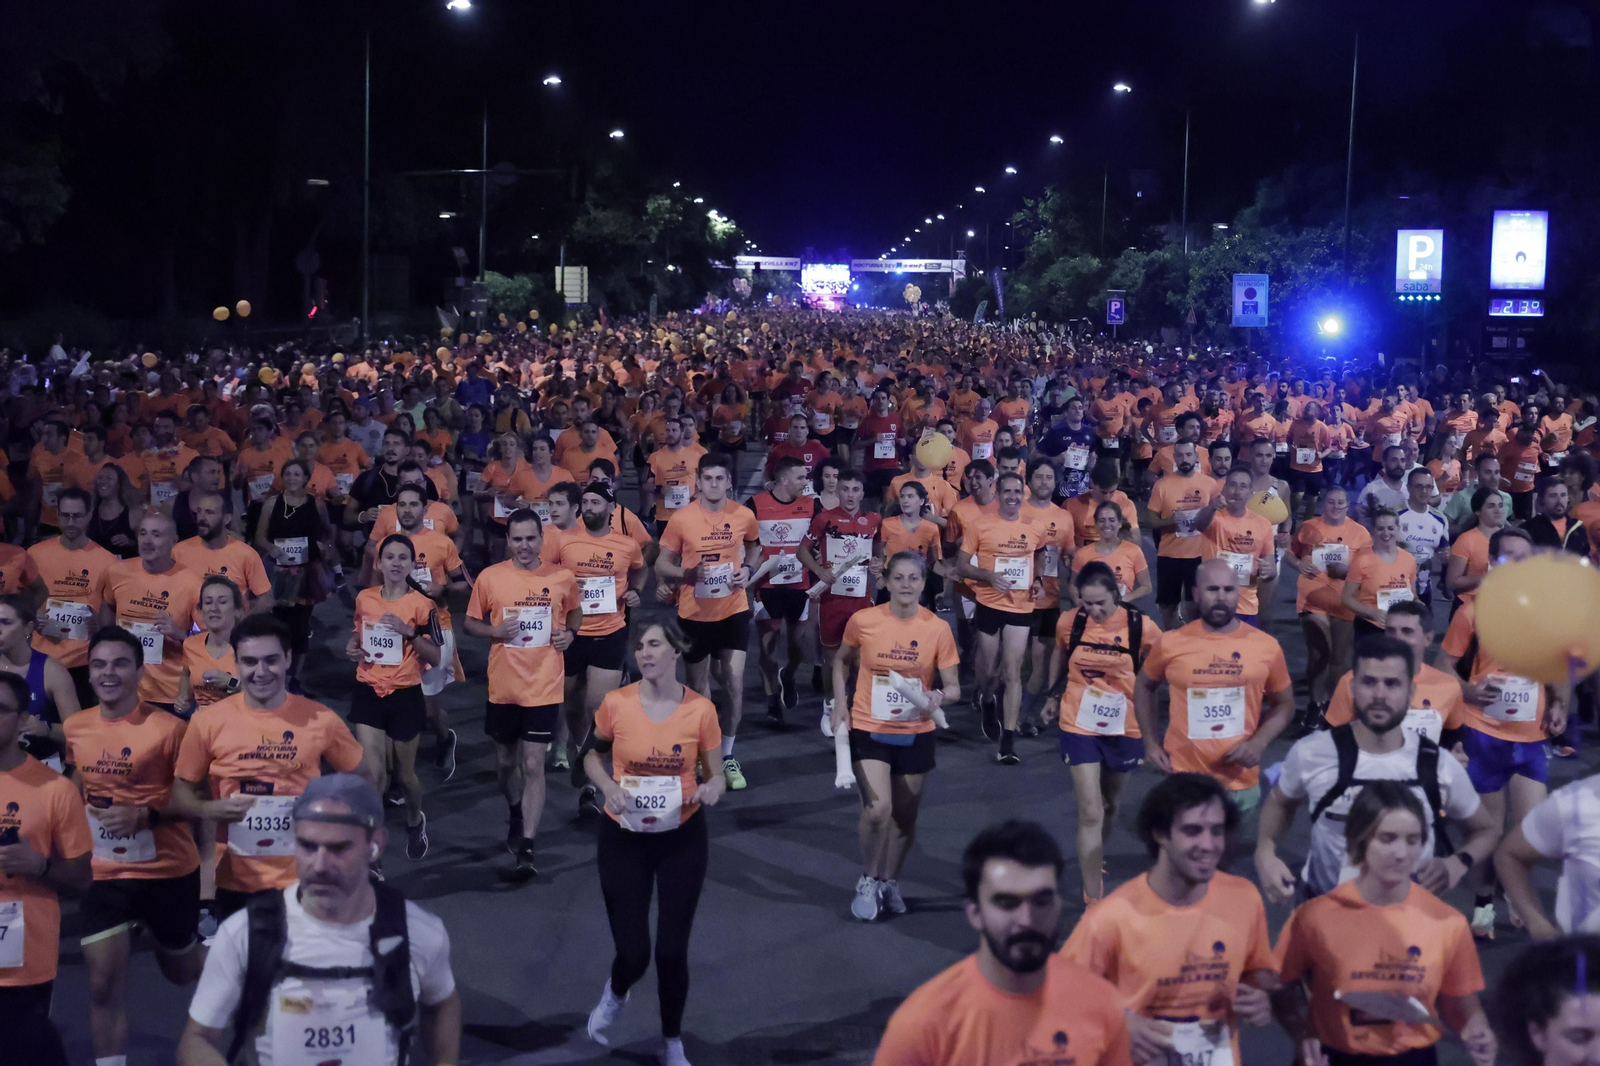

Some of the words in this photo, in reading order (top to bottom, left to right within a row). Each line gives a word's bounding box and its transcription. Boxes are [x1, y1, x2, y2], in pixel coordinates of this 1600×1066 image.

[1403, 281, 1429, 292] saba
[1320, 553, 1341, 561] 10026
[842, 575, 860, 585] 8966
[584, 589, 605, 599] 8681
[55, 613, 83, 625] 14769
[519, 620, 543, 631] 6443
[369, 636, 394, 648] 16439
[1499, 692, 1530, 704] 10210
[1092, 703, 1121, 718] 16226
[1203, 704, 1231, 718] 3550
[238, 751, 275, 760] SEVILLA
[82, 765, 112, 775] SEVILLA
[635, 795, 666, 809] 6282
[246, 816, 290, 831] 13335
[304, 1023, 355, 1049] 2831
